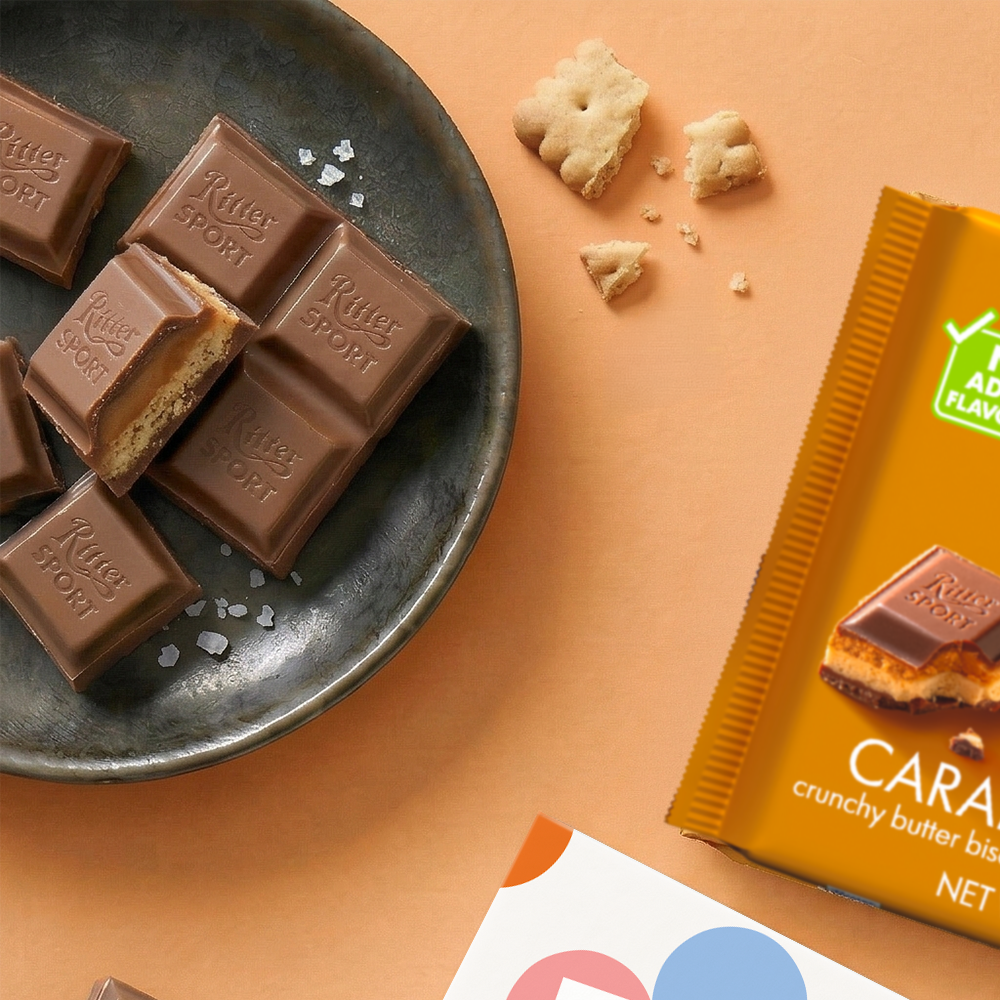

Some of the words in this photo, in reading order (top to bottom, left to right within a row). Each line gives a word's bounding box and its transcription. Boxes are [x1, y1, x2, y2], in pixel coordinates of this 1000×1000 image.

[0, 175, 51, 212] ORT
[189, 170, 280, 244] Ritter
[172, 204, 255, 269] SPORT
[73, 290, 141, 358] Ritter
[300, 307, 379, 375] SPORT
[315, 273, 403, 351] Ritter
[55, 328, 109, 387] SPORT
[201, 437, 278, 503] SPORT
[220, 402, 303, 480] Ritter
[31, 543, 99, 620] SPORT
[51, 517, 131, 602] Ritter
[904, 590, 977, 630] SPORT
[921, 572, 1000, 616] Ritter
[792, 779, 887, 828] crunchy
[890, 804, 961, 847] butter
[936, 871, 996, 911] NET
